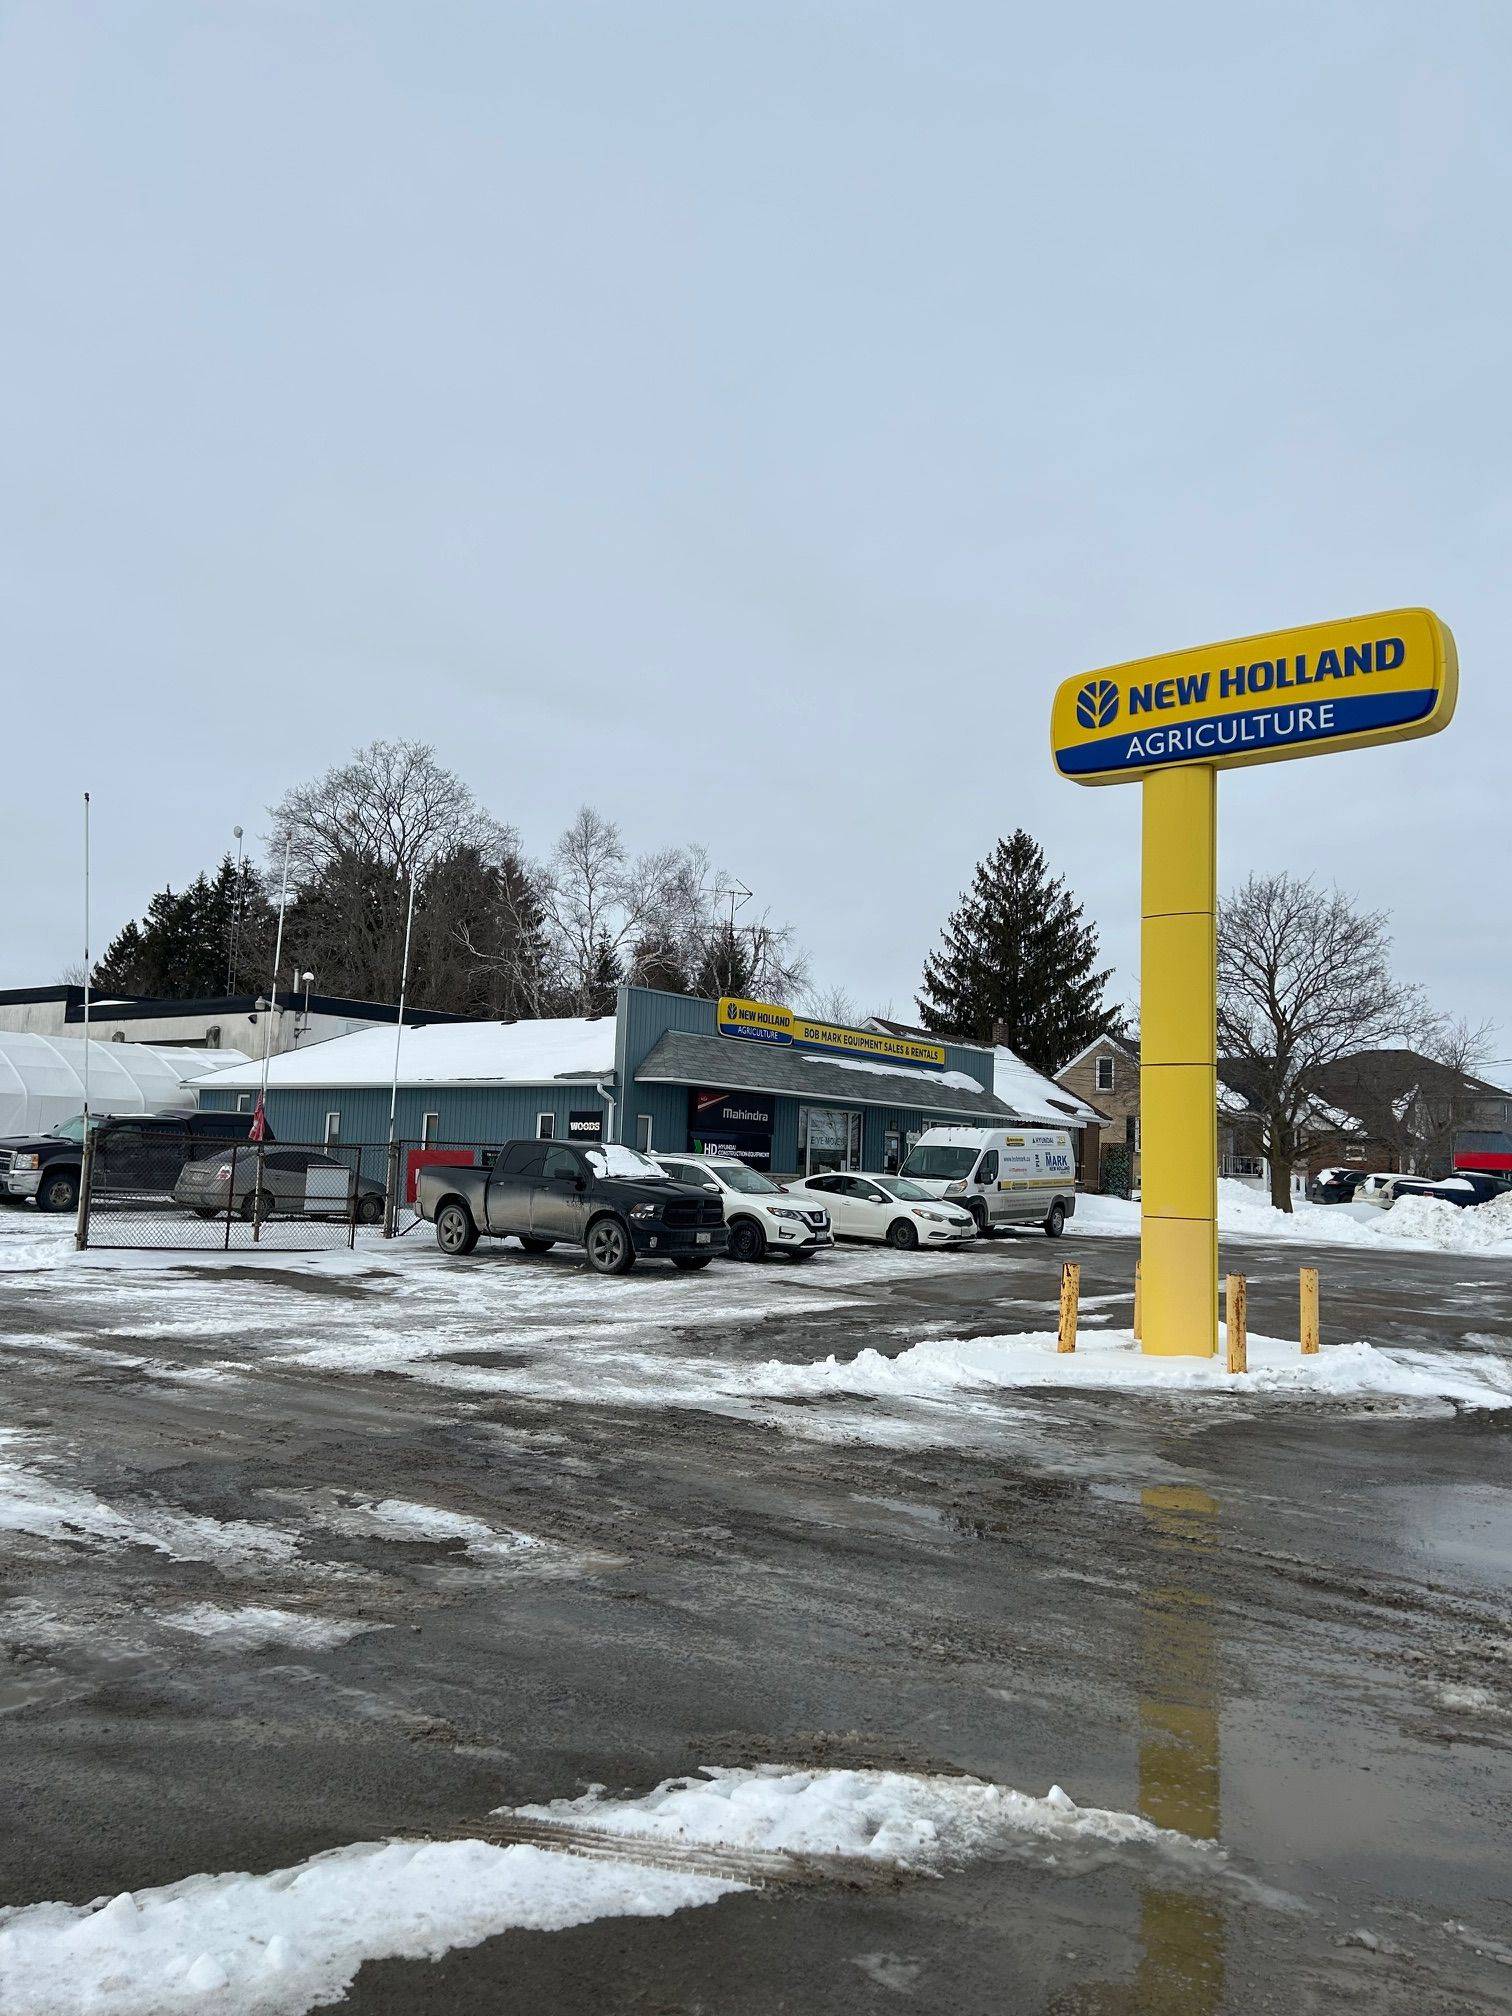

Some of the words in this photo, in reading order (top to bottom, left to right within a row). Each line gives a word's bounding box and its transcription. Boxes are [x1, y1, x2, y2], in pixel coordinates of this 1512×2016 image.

[1128, 671, 1211, 715] NEW
[1219, 637, 1406, 699] HOLLAND
[1126, 704, 1335, 759] AGRICULTURE
[738, 1009, 756, 1021] NEW
[757, 1012, 790, 1027] HOLLAND
[737, 1026, 778, 1040] AGRICULTURE
[804, 1027, 819, 1039] BOB
[821, 1030, 842, 1044] MARK
[843, 1034, 882, 1050] EQUIPMENT
[883, 1043, 903, 1055] SALES
[905, 1047, 910, 1056] &
[911, 1047, 938, 1060] RENTALS
[723, 1108, 768, 1121] Mahindra
[570, 1121, 600, 1131] WOODS
[703, 1142, 718, 1155] HD
[1045, 1155, 1068, 1167] MARK
